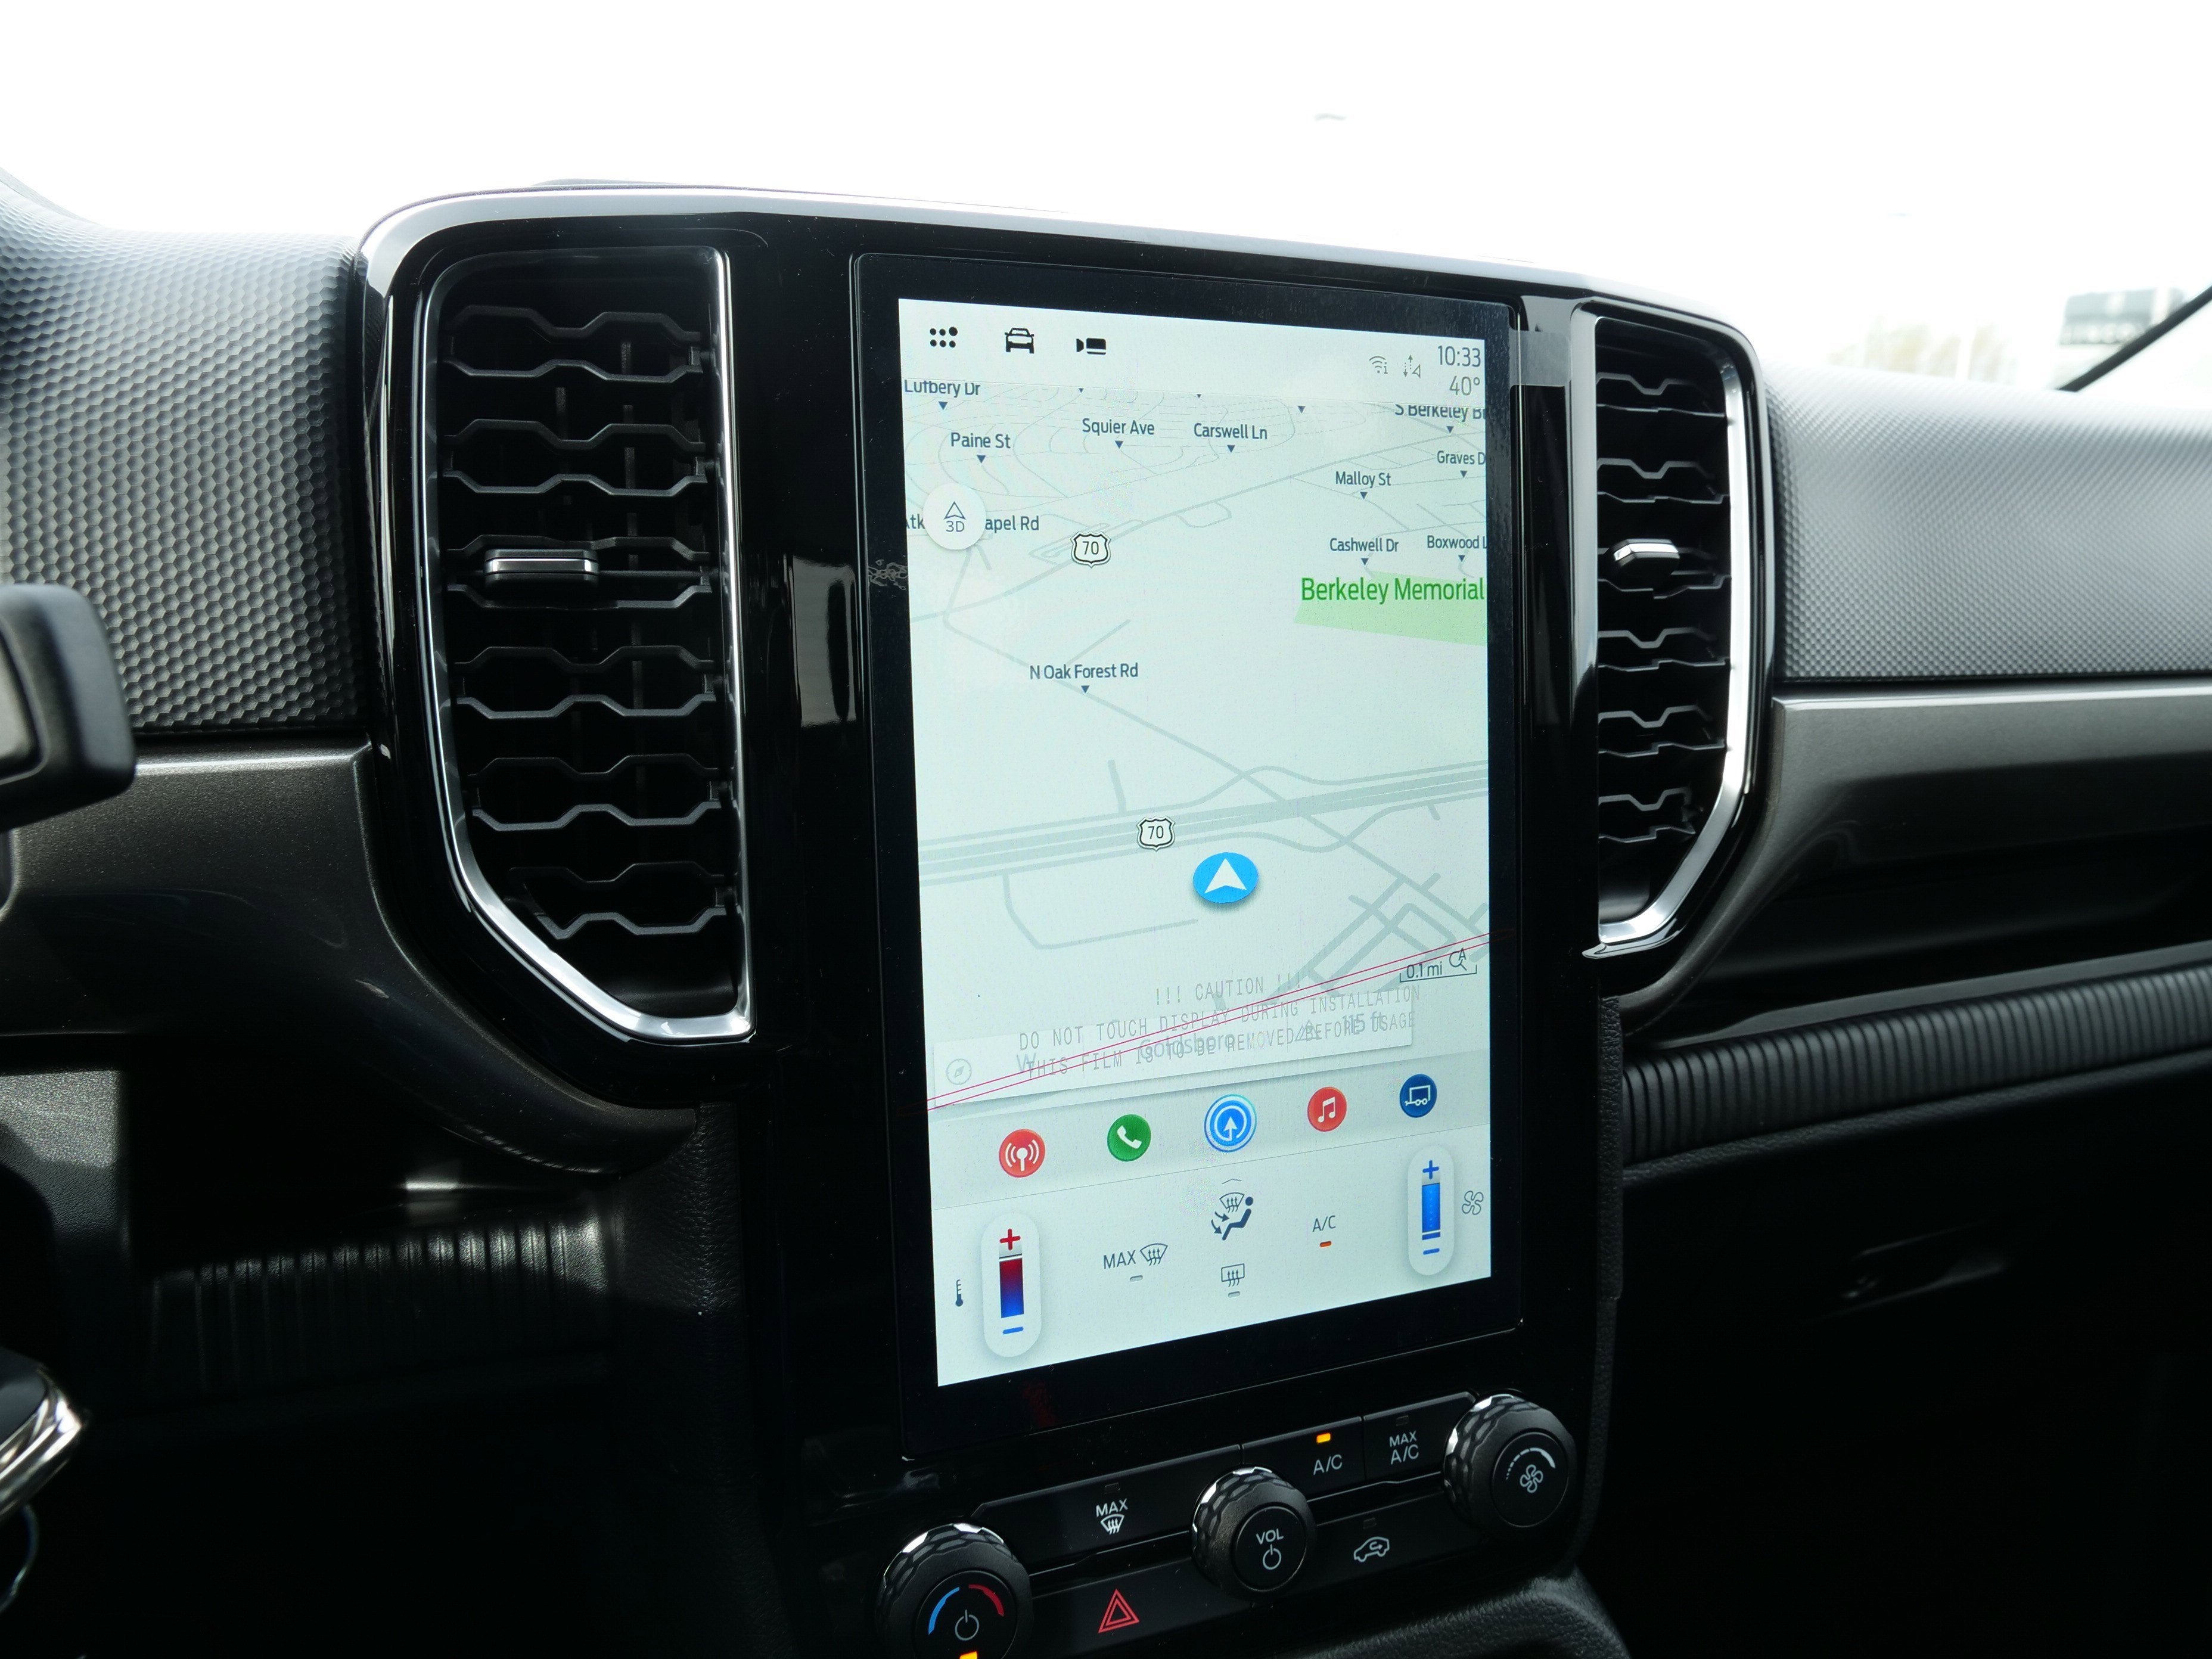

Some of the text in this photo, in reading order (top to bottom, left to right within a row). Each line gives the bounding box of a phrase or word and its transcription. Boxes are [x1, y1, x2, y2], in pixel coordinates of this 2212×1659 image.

[1437, 344, 1481, 368] 10:33
[965, 382, 981, 396] Dr
[1408, 404, 1468, 422] Berkeley
[1082, 418, 1155, 436] Squier Ave
[1193, 423, 1267, 440] Carswell Ln
[950, 432, 1011, 449] Paine St
[1437, 450, 1475, 465] Graves
[1335, 471, 1391, 488] Malloy St
[946, 520, 965, 533] 3D
[984, 514, 1039, 533] apel Rd
[1082, 541, 1099, 555] 70
[1329, 538, 1399, 552] Cashwell Dr
[1427, 535, 1480, 549] Boxwood
[1301, 576, 1484, 605] Berkeley Memorial
[1029, 662, 1139, 680] N Oak Forest Rd
[1148, 825, 1164, 840] 70
[1406, 961, 1443, 978] 0.1 mi
[1195, 975, 1263, 1001] CAUTION
[1020, 984, 1420, 1051] DO NOT TOUCH DISPLAY DURING INSTALLATION
[1026, 1057, 1068, 1079] THIS
[1081, 1049, 1122, 1072] FILM
[1228, 1027, 1294, 1052] REMOVED
[1306, 1018, 1361, 1042] BEFORE
[1372, 1011, 1415, 1033] USAGE
[1312, 1215, 1337, 1233] A/C
[1102, 1250, 1136, 1270] MAX
[1389, 1431, 1418, 1447] MAX
[1390, 1444, 1419, 1465] A/C
[1313, 1454, 1343, 1475] A/C
[1095, 1499, 1128, 1517] MAX
[1256, 1528, 1284, 1545] VOL
